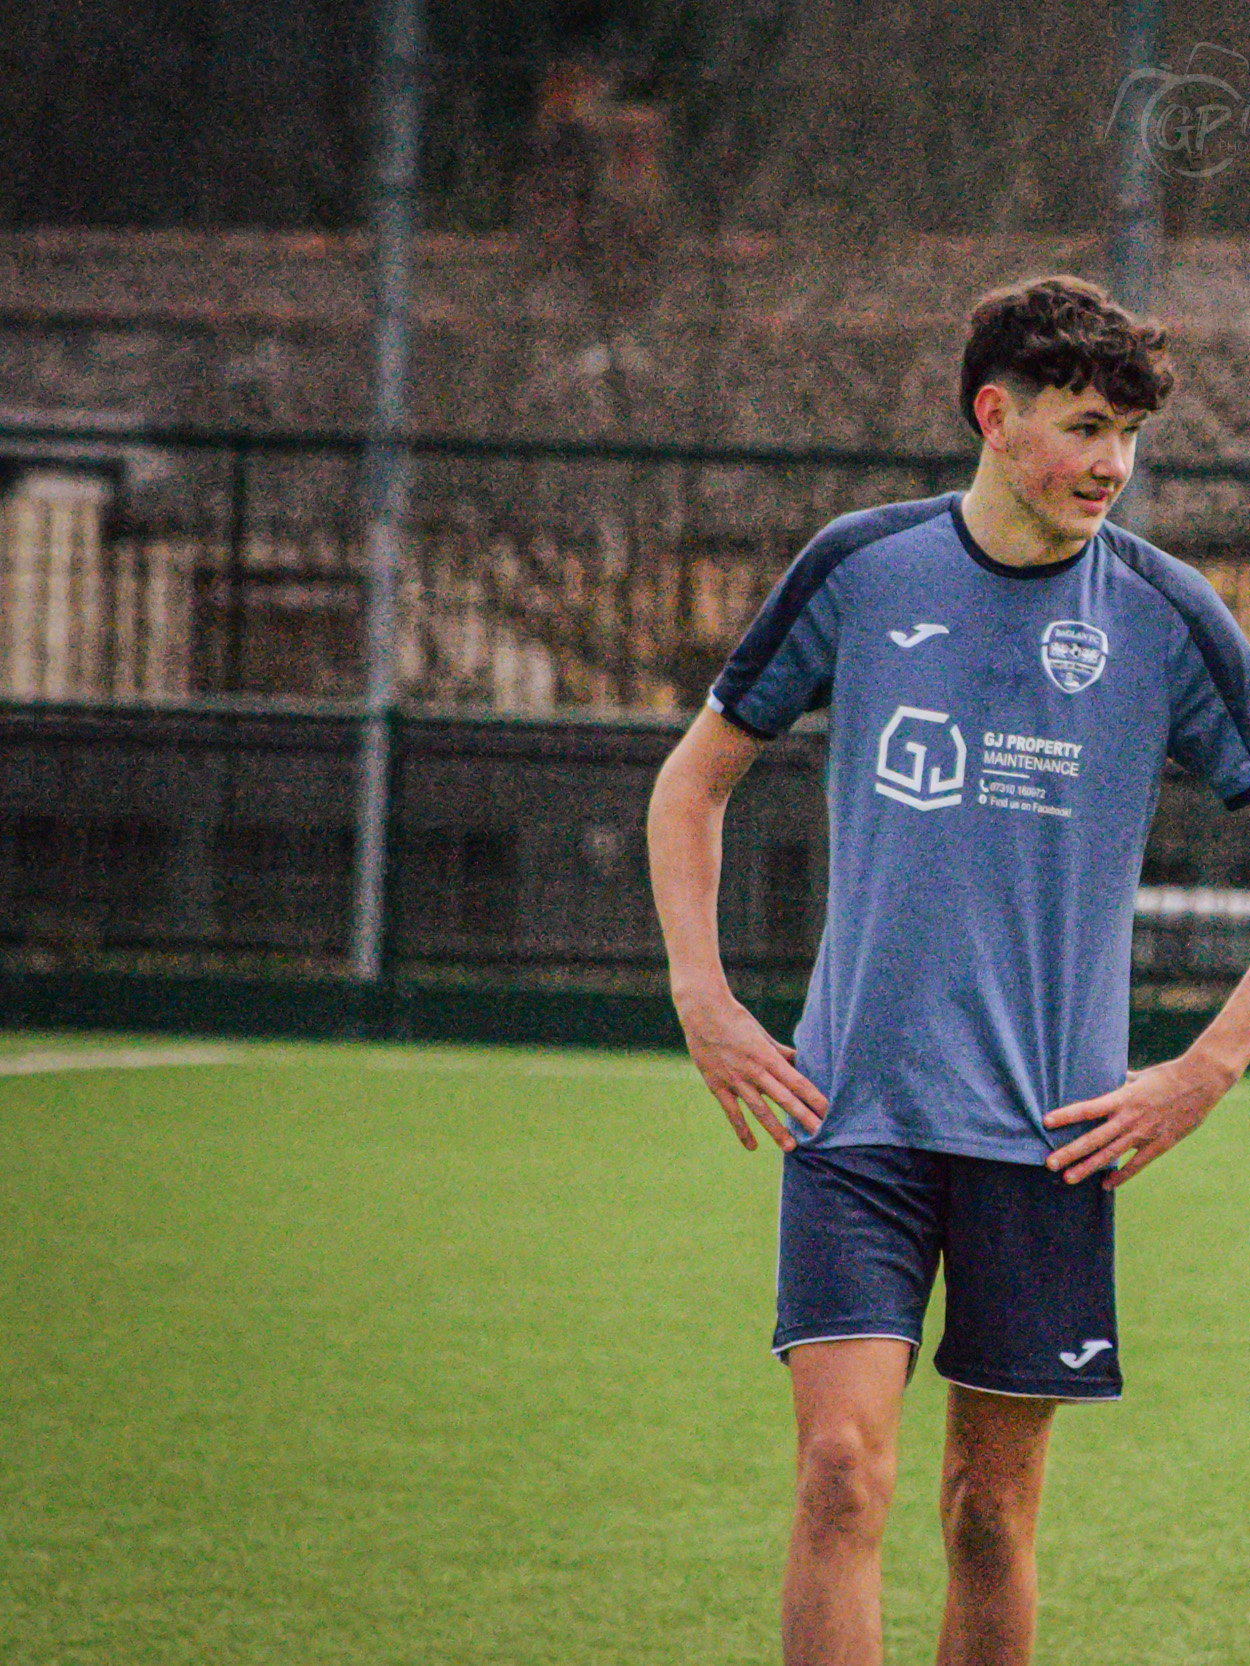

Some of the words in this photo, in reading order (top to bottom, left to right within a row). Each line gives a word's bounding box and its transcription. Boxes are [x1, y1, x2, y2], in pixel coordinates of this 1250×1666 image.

[983, 732, 1004, 748] GJ
[1006, 734, 1083, 759] PROPERTY
[984, 750, 1080, 777] MAINTENANCE
